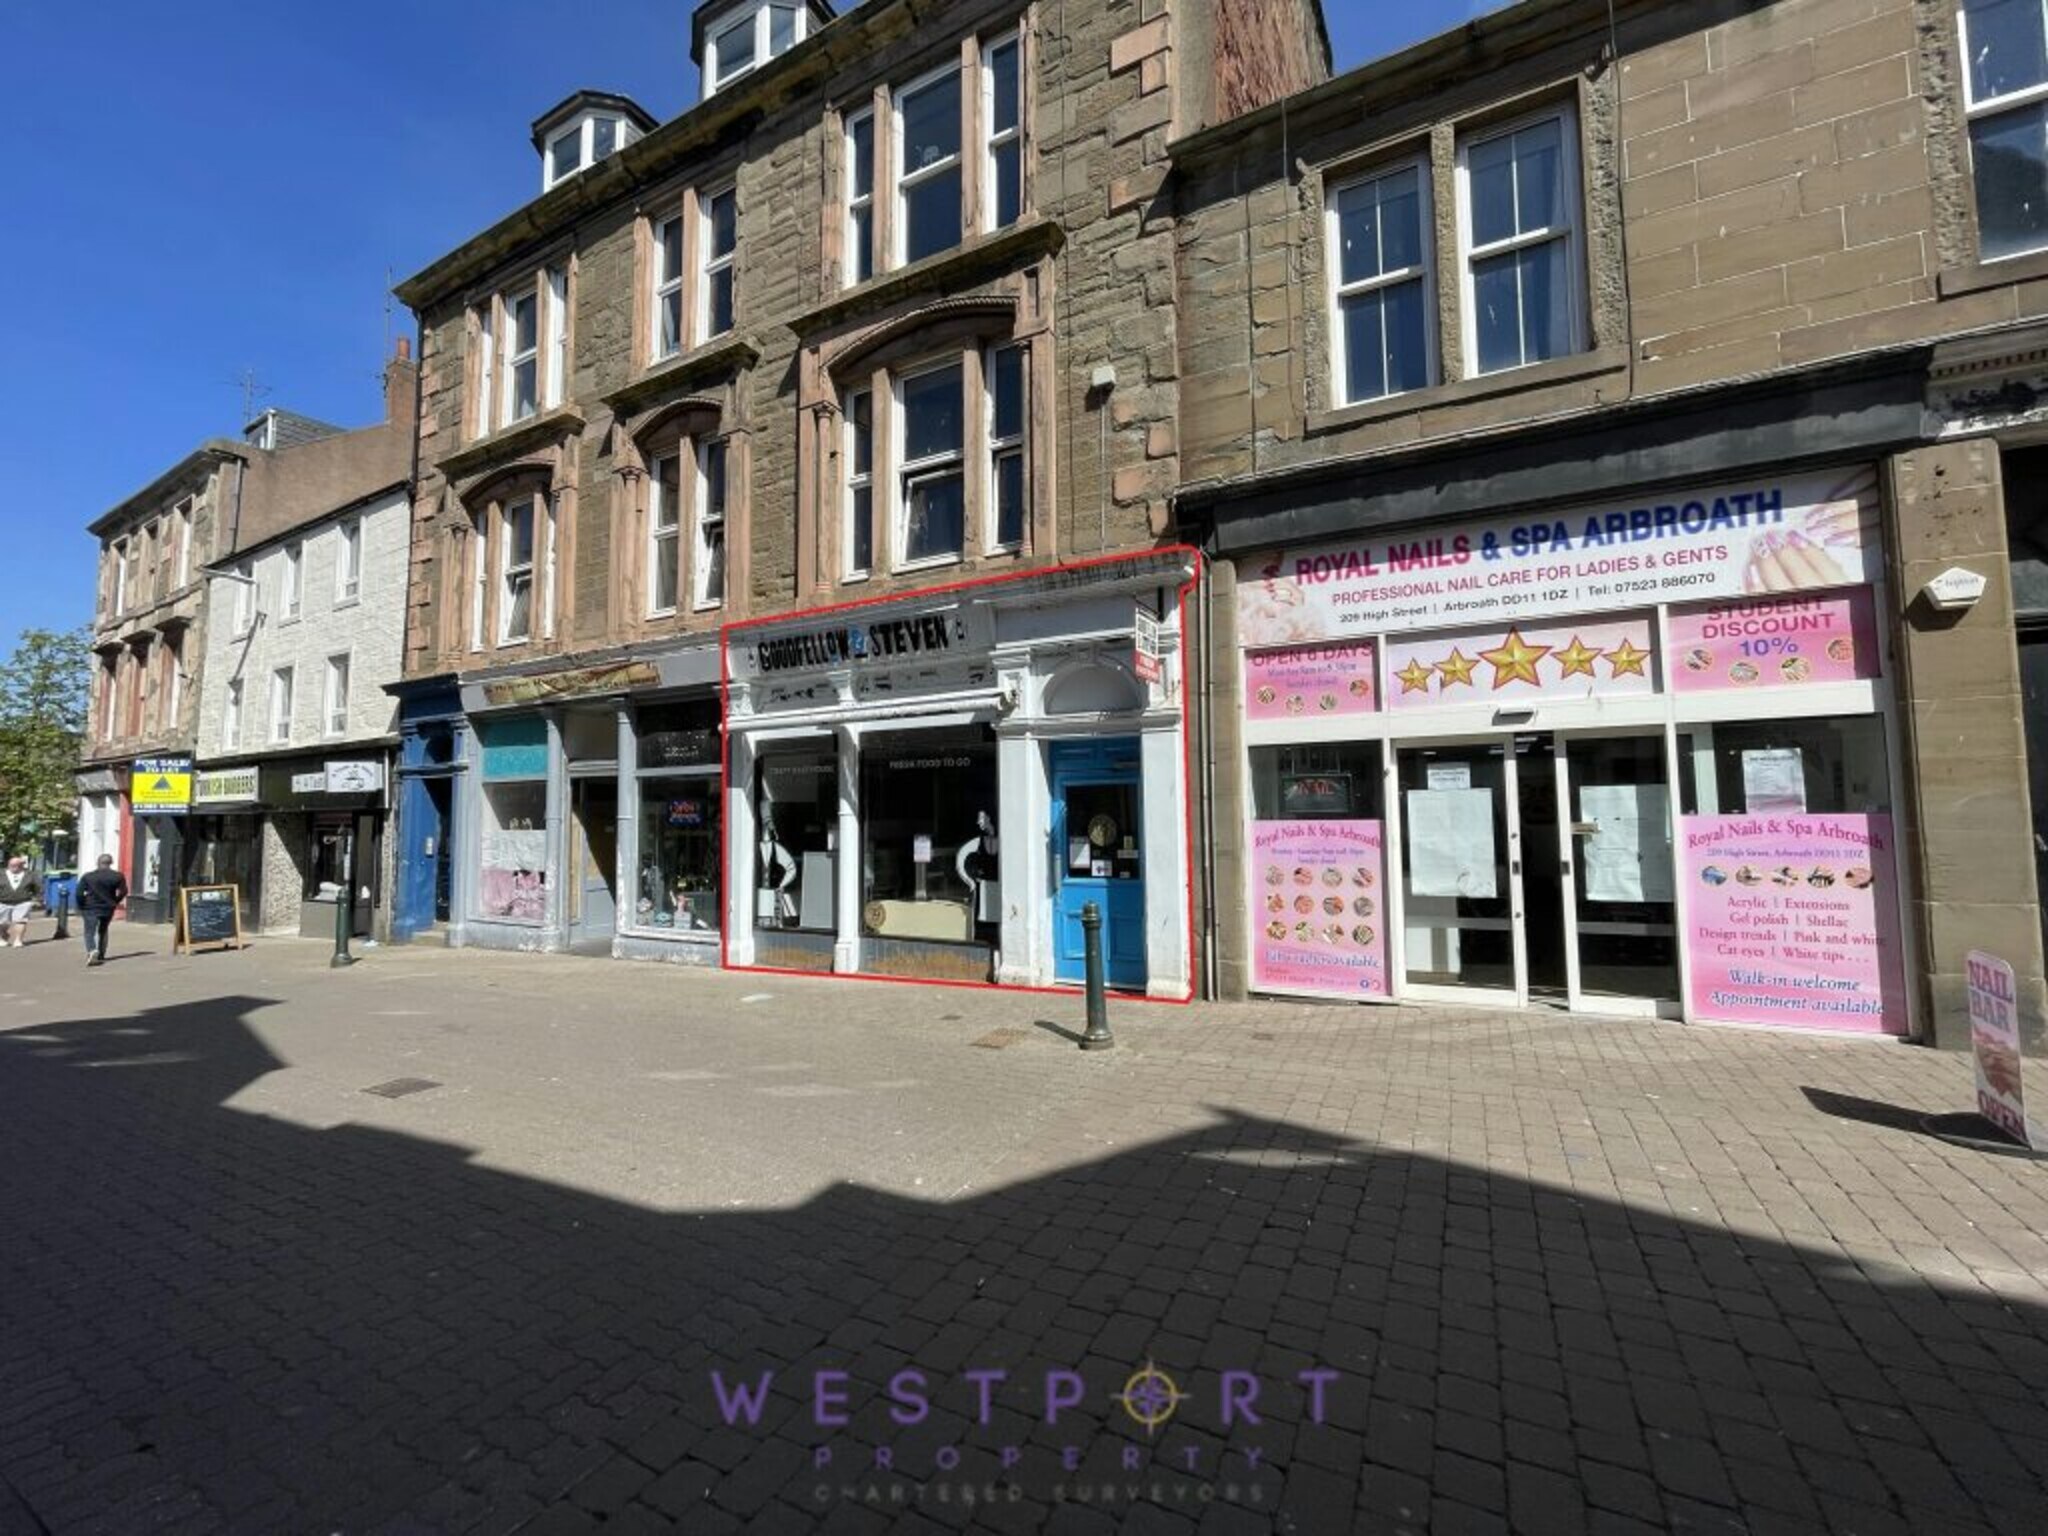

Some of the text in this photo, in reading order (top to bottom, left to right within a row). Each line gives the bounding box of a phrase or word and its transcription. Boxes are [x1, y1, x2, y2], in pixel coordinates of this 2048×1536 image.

[1296, 488, 1783, 586] ROYAL NAILS & SPA ARBROATH
[1332, 545, 1729, 607] PROFESSIONAL NAIL CARE FOR LADIES & GENTS
[1362, 608, 1390, 623] High
[1392, 605, 1428, 618] Street
[1443, 597, 1500, 613] Arbroath
[1502, 592, 1537, 606] DD11
[1541, 589, 1569, 602] 1DZ
[1588, 584, 1611, 597] Tel:
[1615, 578, 1657, 594] 07523
[1707, 595, 1825, 621] STUDENT
[1702, 612, 1836, 639] DISCOUNT
[757, 629, 852, 672] GOODFELLOW
[869, 615, 950, 658] STEVEN
[1252, 649, 1302, 667] OPEN
[1323, 640, 1373, 661] DAYS
[1739, 636, 1799, 657] 10%
[943, 757, 954, 767] TO
[956, 756, 971, 767] GO
[1688, 818, 1885, 850] Royal Nails & Spa Arbroath
[1727, 896, 1850, 911] Acrylic Extensions
[1729, 911, 1849, 928] Gel polish Shellac
[1699, 927, 1737, 941] Design
[1741, 929, 1777, 942] trends
[1793, 931, 1822, 944] Pink
[1826, 933, 1849, 945] and
[1717, 943, 1845, 963] Cat eyes White tips
[1729, 968, 1861, 992] Walk-in welcome
[1967, 959, 2014, 1004] NAIL
[1711, 990, 1886, 1015] Appointment available
[1968, 987, 2011, 1034] BAR
[1977, 1088, 2028, 1144] OPEN
